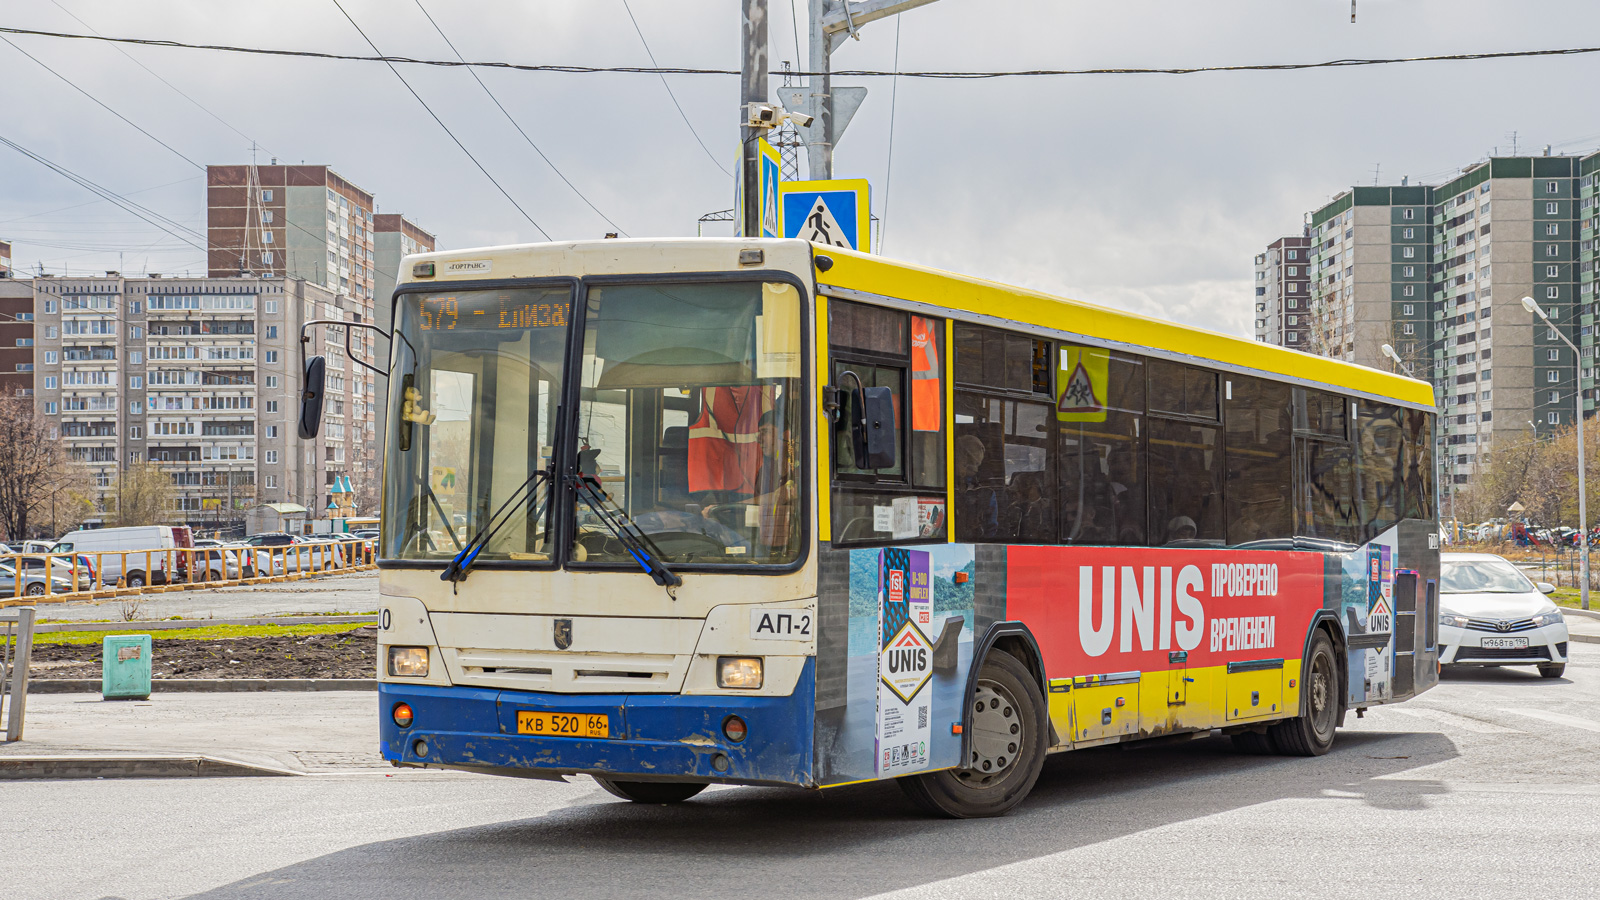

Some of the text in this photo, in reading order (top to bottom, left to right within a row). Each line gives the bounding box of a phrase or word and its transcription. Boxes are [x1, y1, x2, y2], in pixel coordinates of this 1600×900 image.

[420, 297, 459, 331] 579
[1211, 563, 1279, 598] ПРОВЕРЕНО
[756, 613, 811, 635] АП-2
[1078, 564, 1205, 657] UNIS
[1370, 615, 1389, 632] UNIS
[1210, 615, 1276, 653] ВРЕМЕНЕМ
[888, 648, 927, 674] UNIS
[526, 715, 603, 733] КВ 520 66
